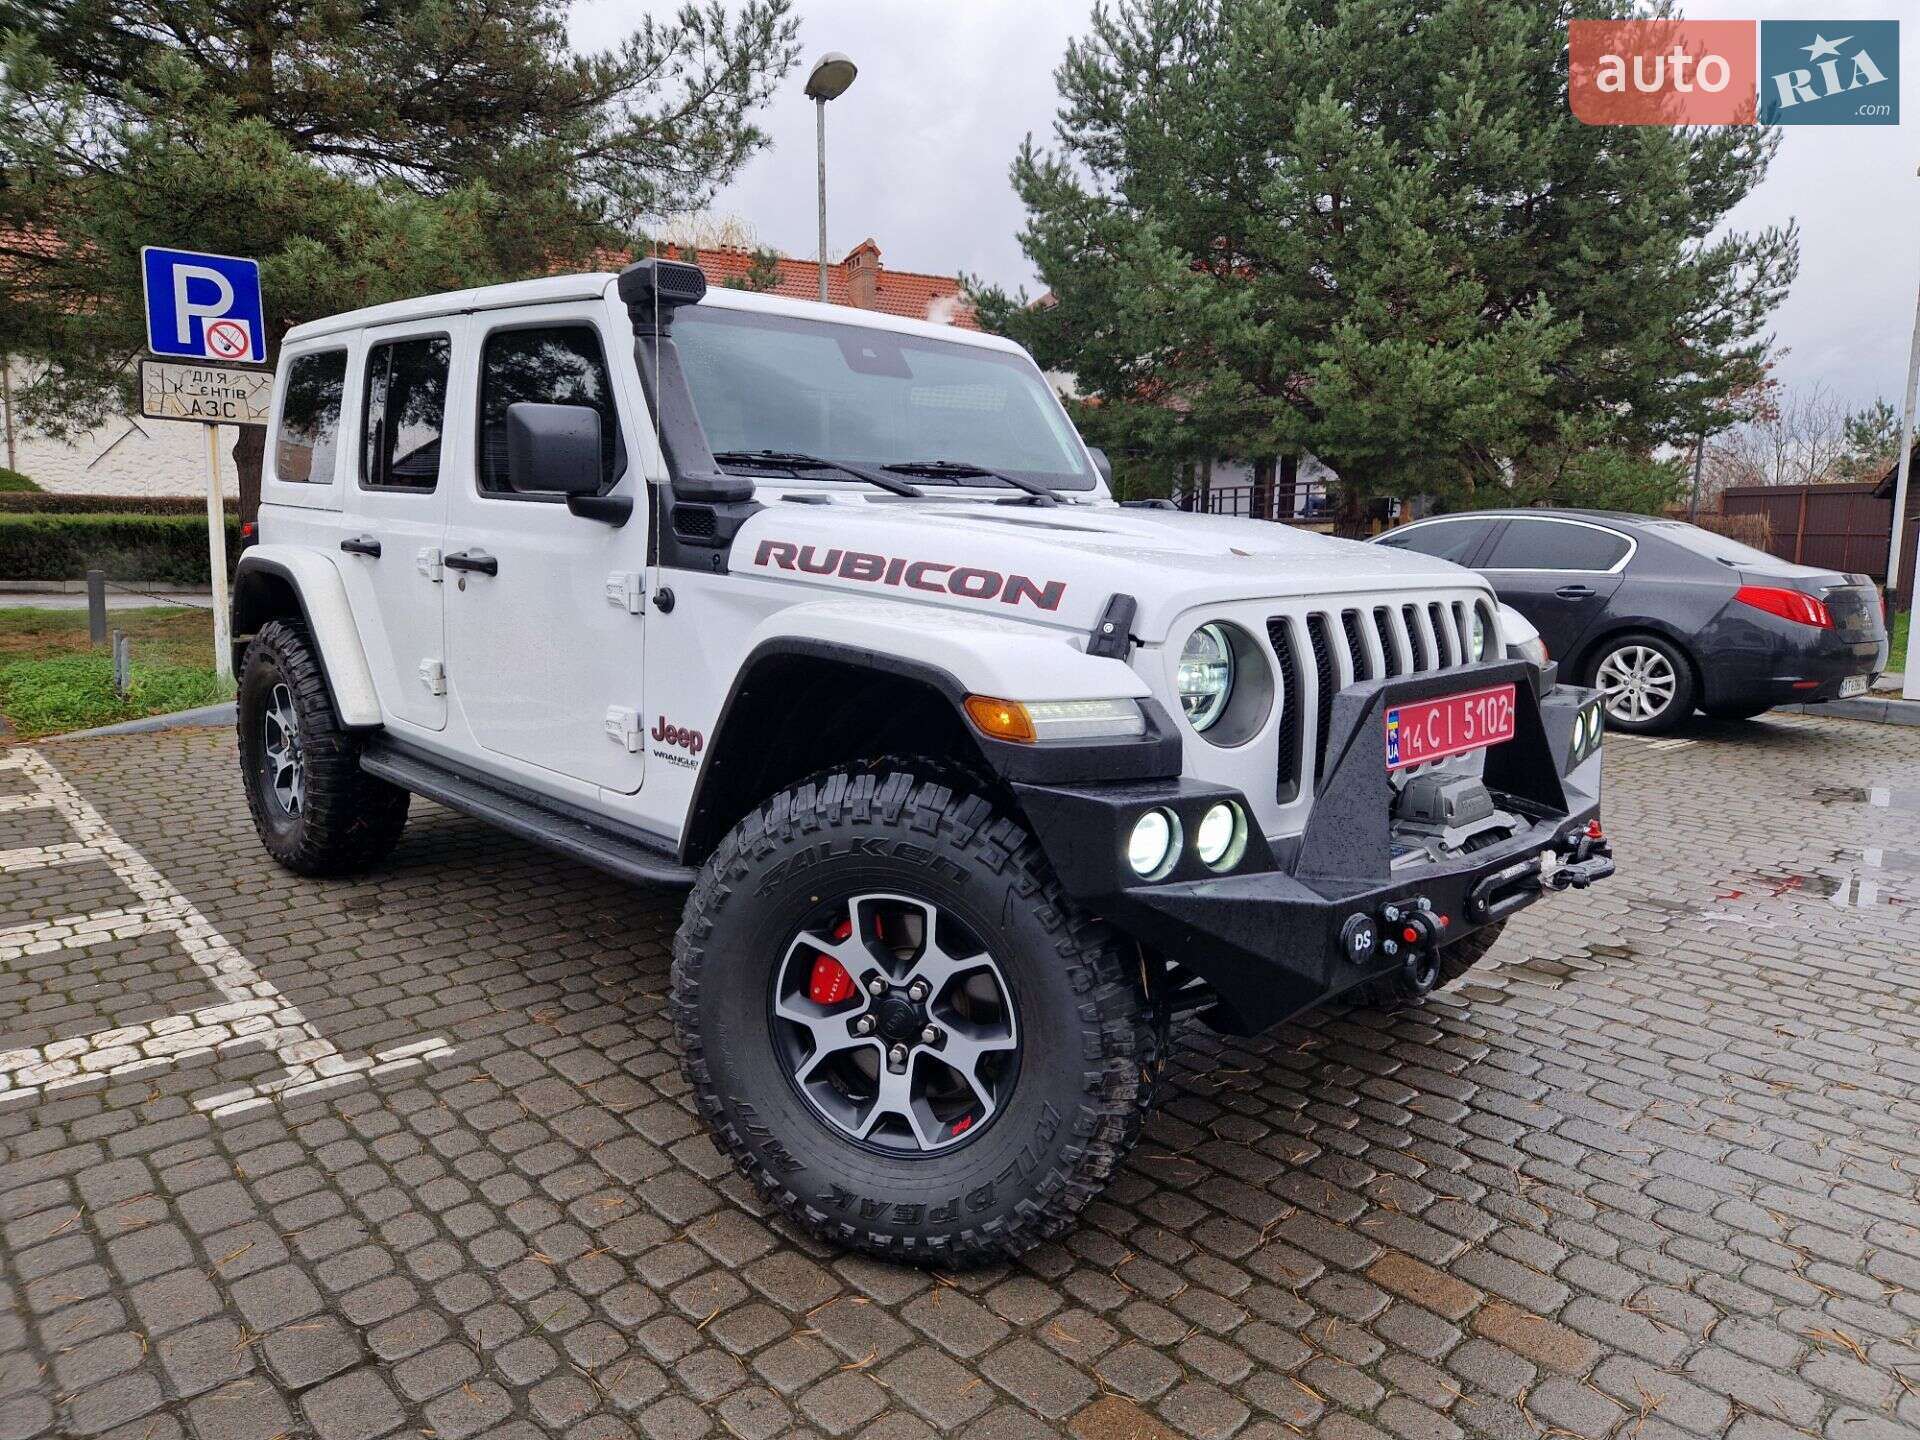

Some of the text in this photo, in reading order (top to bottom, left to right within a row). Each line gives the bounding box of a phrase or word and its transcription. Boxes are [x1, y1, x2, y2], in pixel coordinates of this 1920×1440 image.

[173, 263, 234, 344] P
[754, 539, 1067, 611] RUBICON
[651, 715, 704, 757] Jeep
[1463, 694, 1508, 740] 5102
[1388, 742, 1399, 759] UA
[1354, 929, 1372, 951] DS
